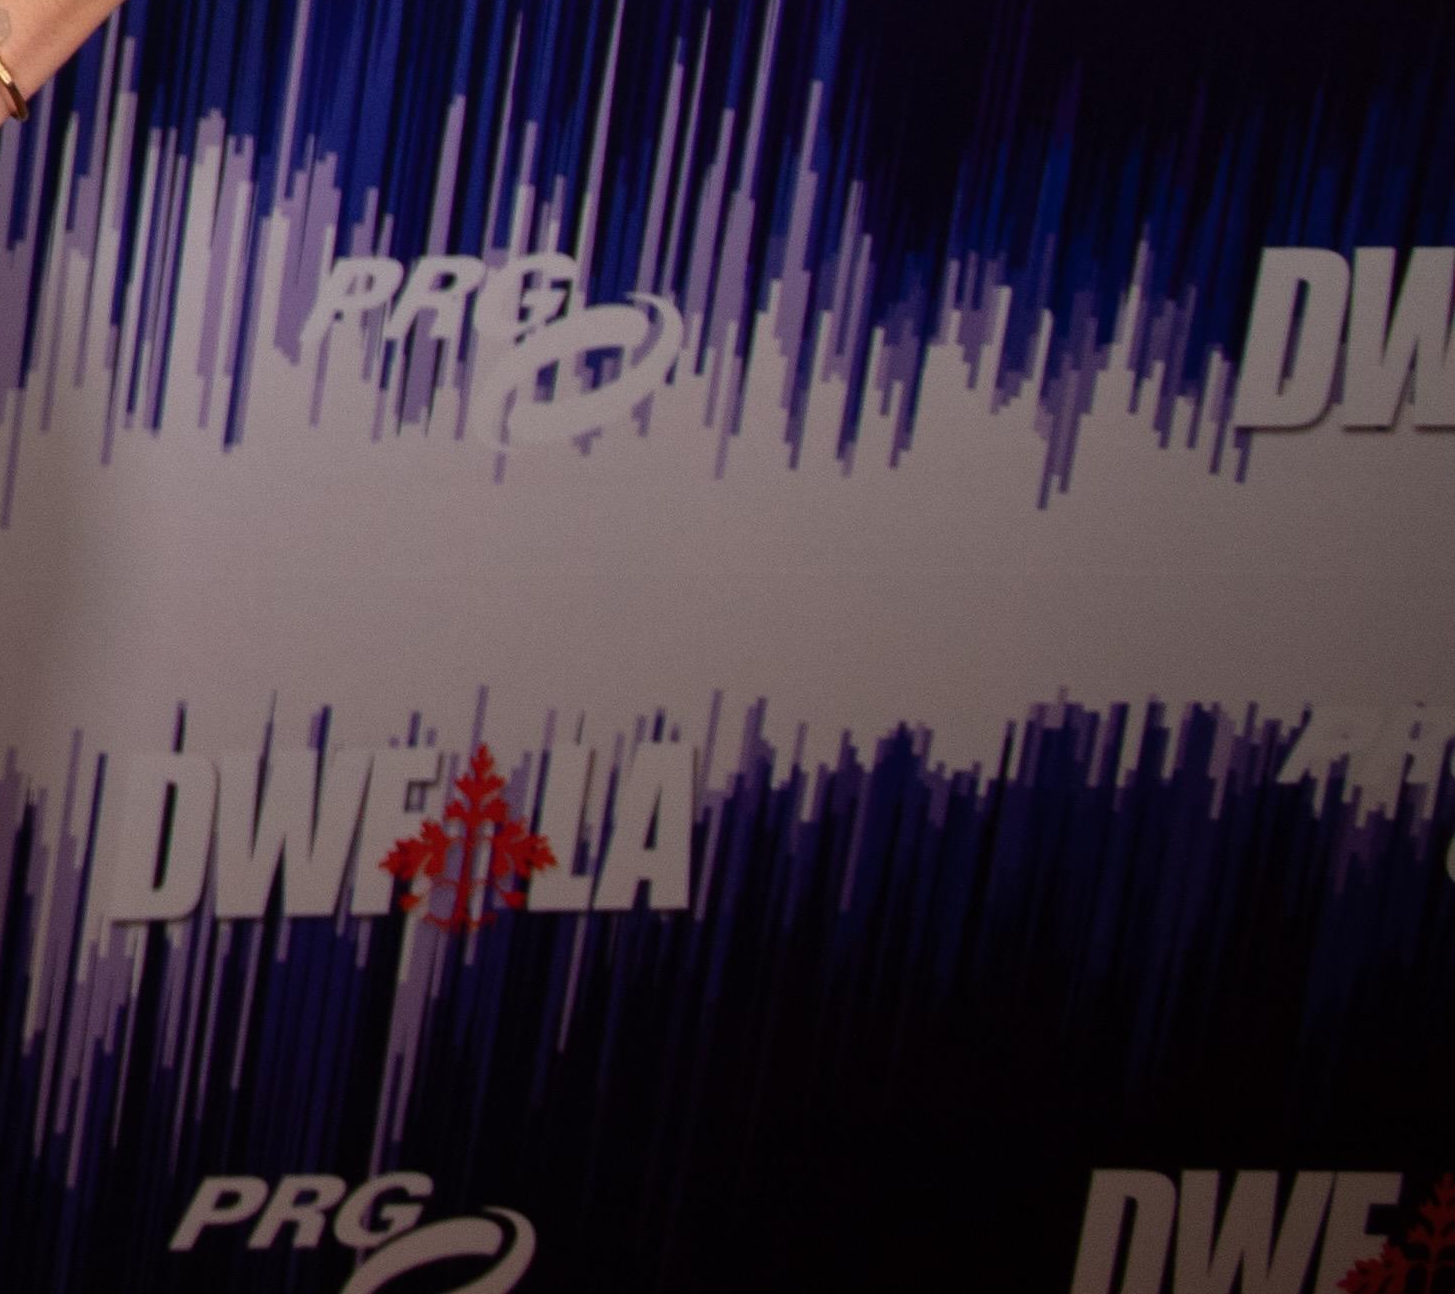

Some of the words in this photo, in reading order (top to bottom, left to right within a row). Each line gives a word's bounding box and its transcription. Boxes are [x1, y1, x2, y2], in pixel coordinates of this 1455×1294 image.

[109, 746, 445, 921] DWF
[525, 743, 698, 913] LA
[167, 1169, 436, 1255] PRG
